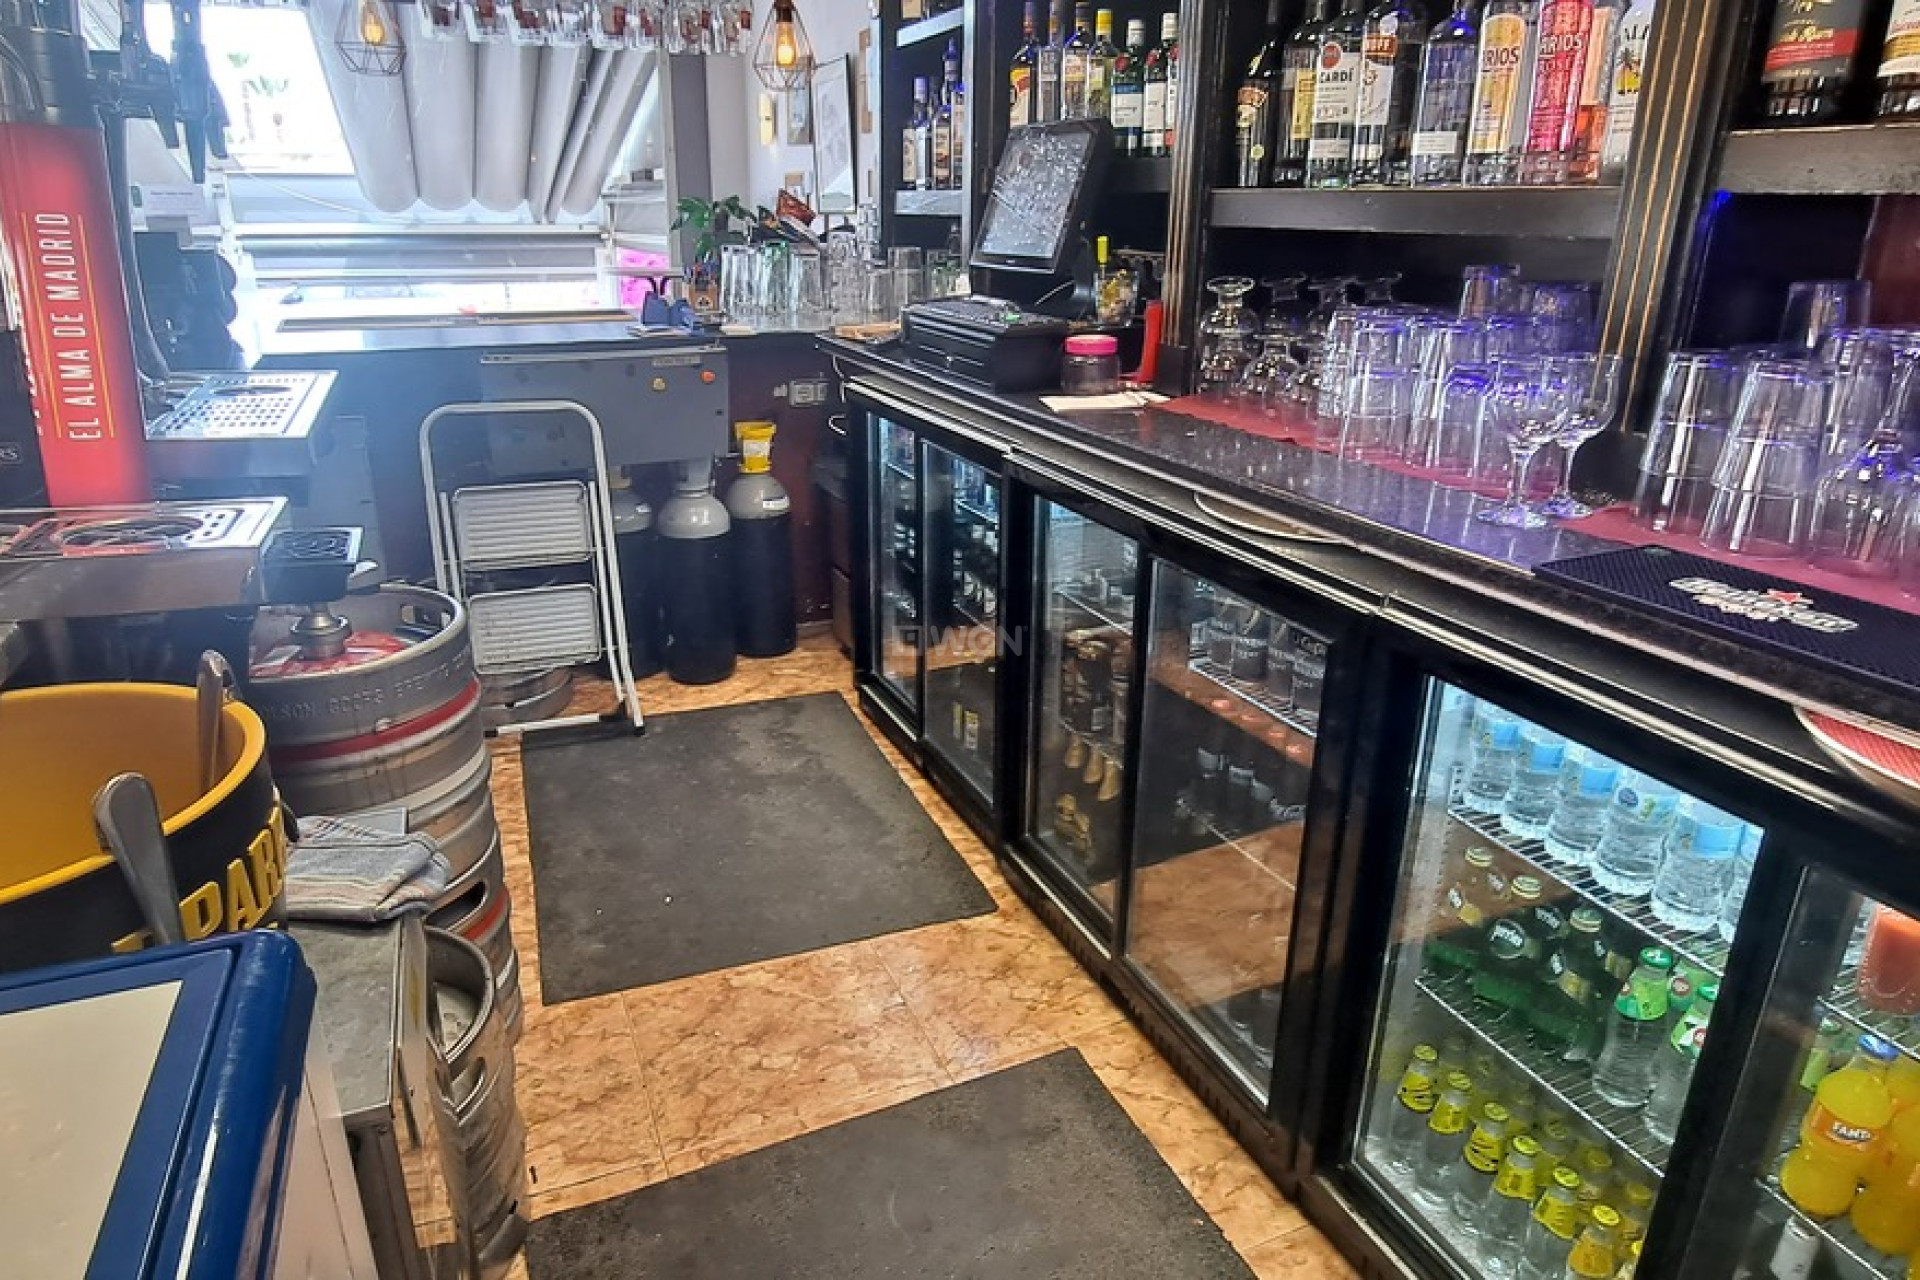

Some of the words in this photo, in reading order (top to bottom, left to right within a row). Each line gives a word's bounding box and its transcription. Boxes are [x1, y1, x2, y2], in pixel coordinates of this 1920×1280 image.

[34, 213, 81, 301] MADRID
[50, 312, 87, 338] DE
[56, 349, 97, 406] ALMA
[67, 416, 102, 440] EL
